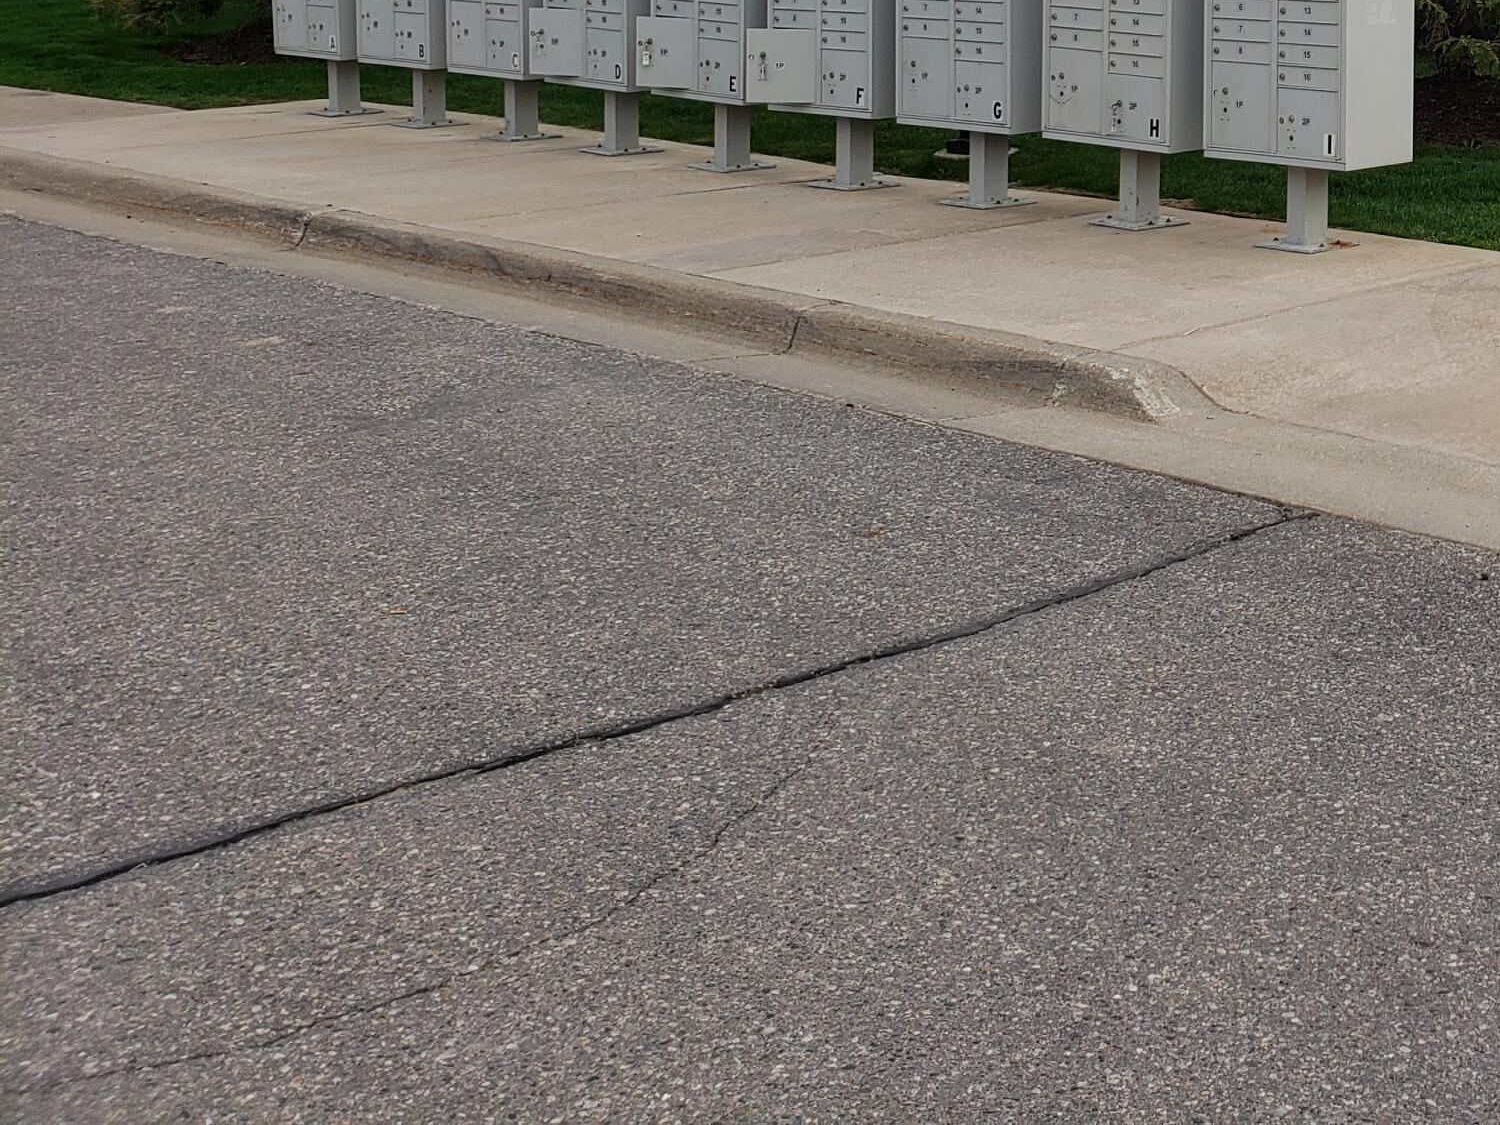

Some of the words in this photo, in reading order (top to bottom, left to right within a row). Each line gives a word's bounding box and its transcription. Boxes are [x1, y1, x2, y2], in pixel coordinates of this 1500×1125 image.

[1238, 3, 1244, 11] 6
[1303, 6, 1312, 15] 13
[1073, 13, 1079, 21] 7
[1132, 18, 1140, 26] 14
[1238, 24, 1244, 33] 7
[1304, 28, 1312, 36] 14
[1132, 39, 1140, 47] 15
[418, 43, 425, 58] B
[1238, 46, 1243, 55] 8
[1303, 50, 1311, 59] 15
[614, 63, 622, 80] D
[729, 75, 737, 93] E
[1070, 85, 1079, 93] 1P
[855, 87, 865, 105] F
[1129, 102, 1138, 111] 2P
[1235, 100, 1244, 109] 1P
[993, 101, 1002, 120] G
[1301, 117, 1311, 126] 2P
[1149, 118, 1160, 138] H
